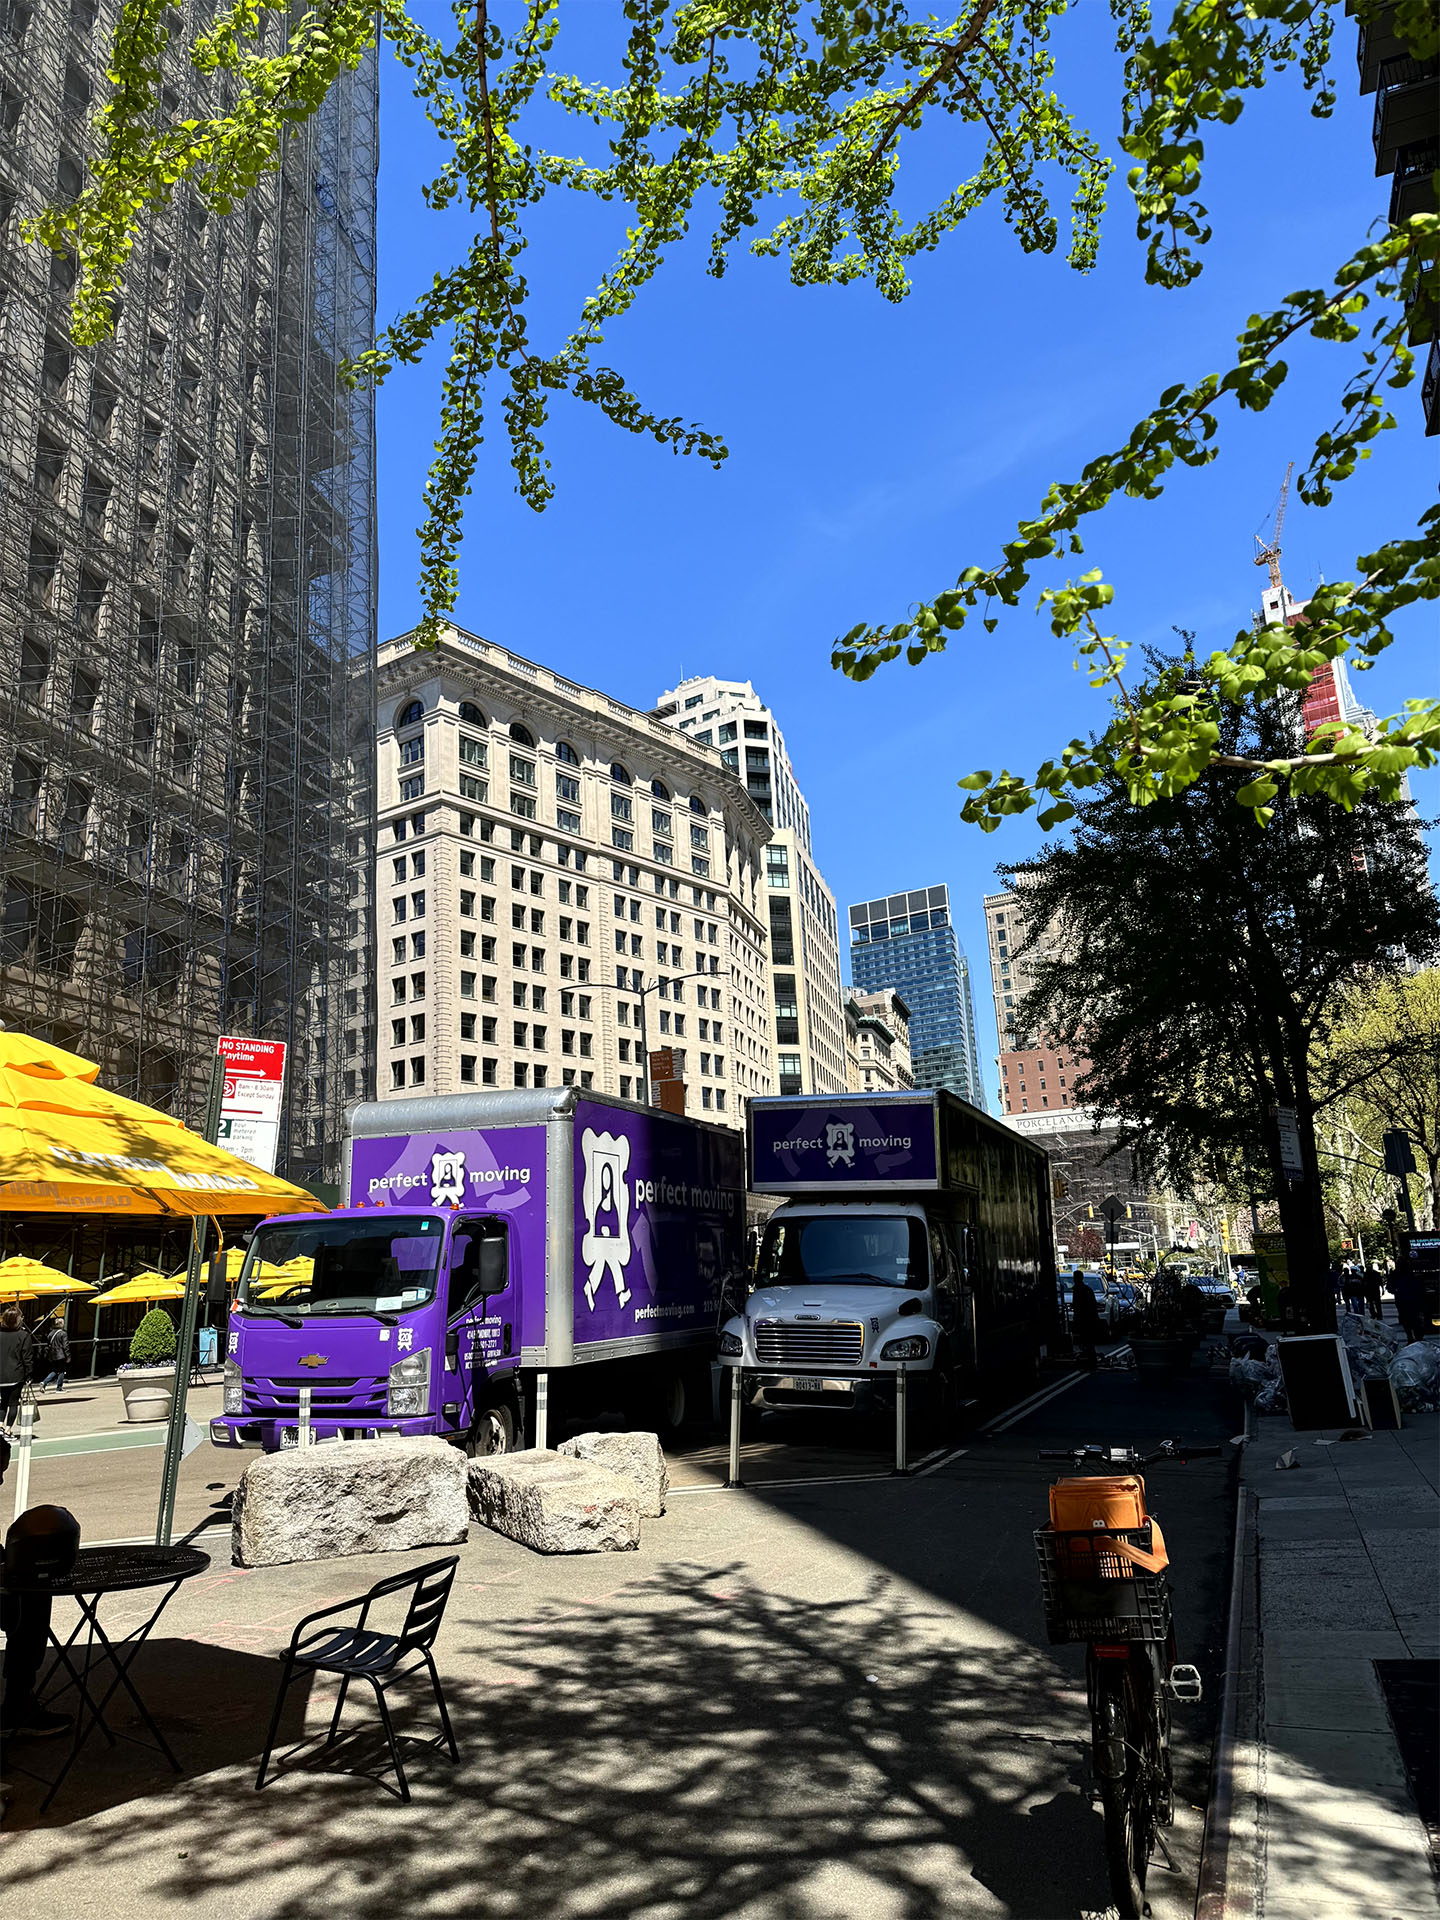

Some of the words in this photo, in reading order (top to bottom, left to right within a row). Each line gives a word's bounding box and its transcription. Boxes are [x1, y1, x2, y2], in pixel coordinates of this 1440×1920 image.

[222, 1041, 233, 1050] NO
[235, 1043, 275, 1054] STANDING
[256, 1092, 275, 1100] Sunday
[218, 1119, 227, 1136] 2
[772, 1137, 823, 1152] perfect
[859, 1135, 912, 1149] moving
[171, 1171, 259, 1190] NOMAD
[369, 1173, 428, 1193] perfect
[469, 1165, 531, 1184] moving
[56, 1195, 132, 1207] NOMAD
[635, 1175, 688, 1209] perfect
[690, 1184, 735, 1218] moving
[485, 1315, 501, 1326] moving
[634, 1303, 695, 1323] perfectmoving.com
